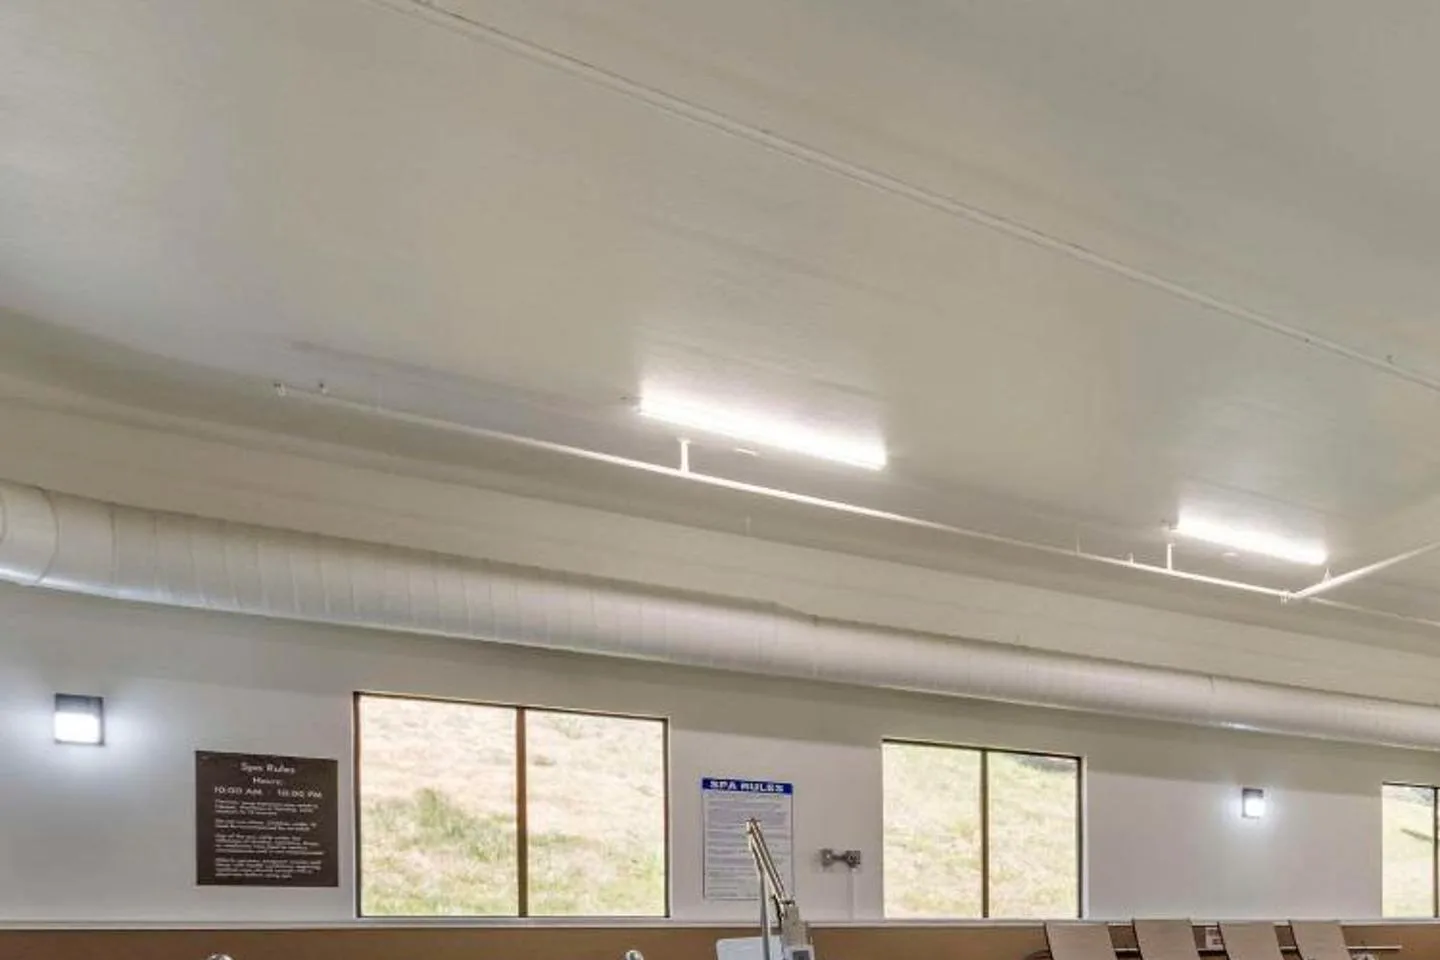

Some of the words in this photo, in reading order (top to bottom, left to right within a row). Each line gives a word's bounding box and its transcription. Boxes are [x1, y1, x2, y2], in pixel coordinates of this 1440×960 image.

[266, 763, 296, 774] Rules
[710, 780, 737, 790] SPA
[740, 782, 785, 792] RULES
